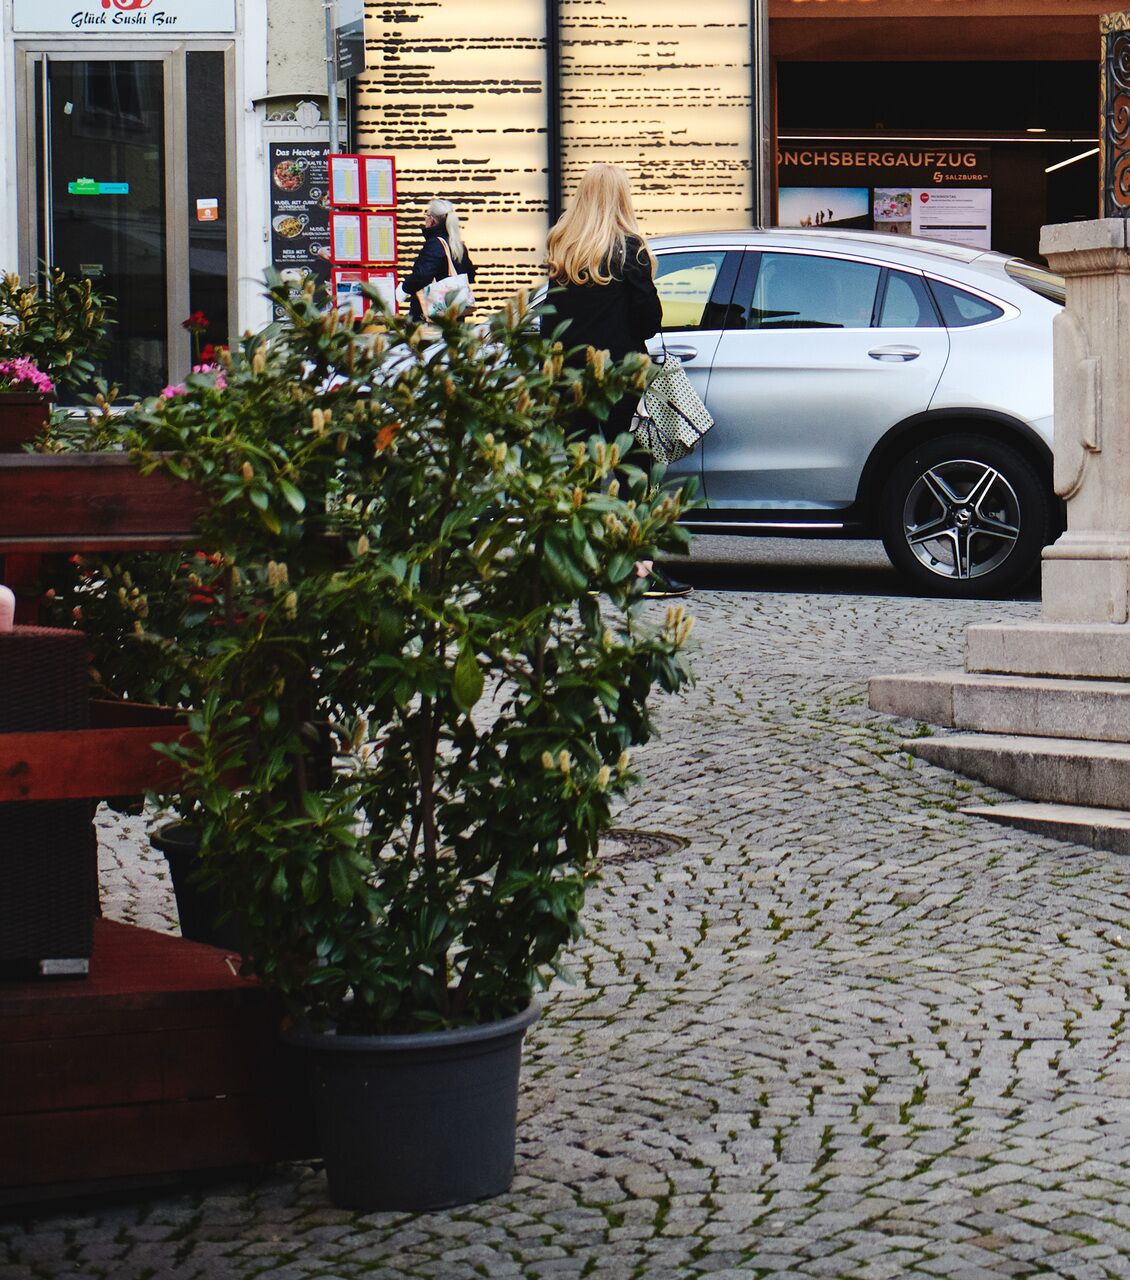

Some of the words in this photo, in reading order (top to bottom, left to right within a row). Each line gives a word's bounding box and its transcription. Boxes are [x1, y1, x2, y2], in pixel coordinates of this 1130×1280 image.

[71, 11, 107, 28] Glück
[112, 11, 147, 26] Sushi
[152, 11, 178, 26] Bar
[292, 148, 320, 158] Heutige
